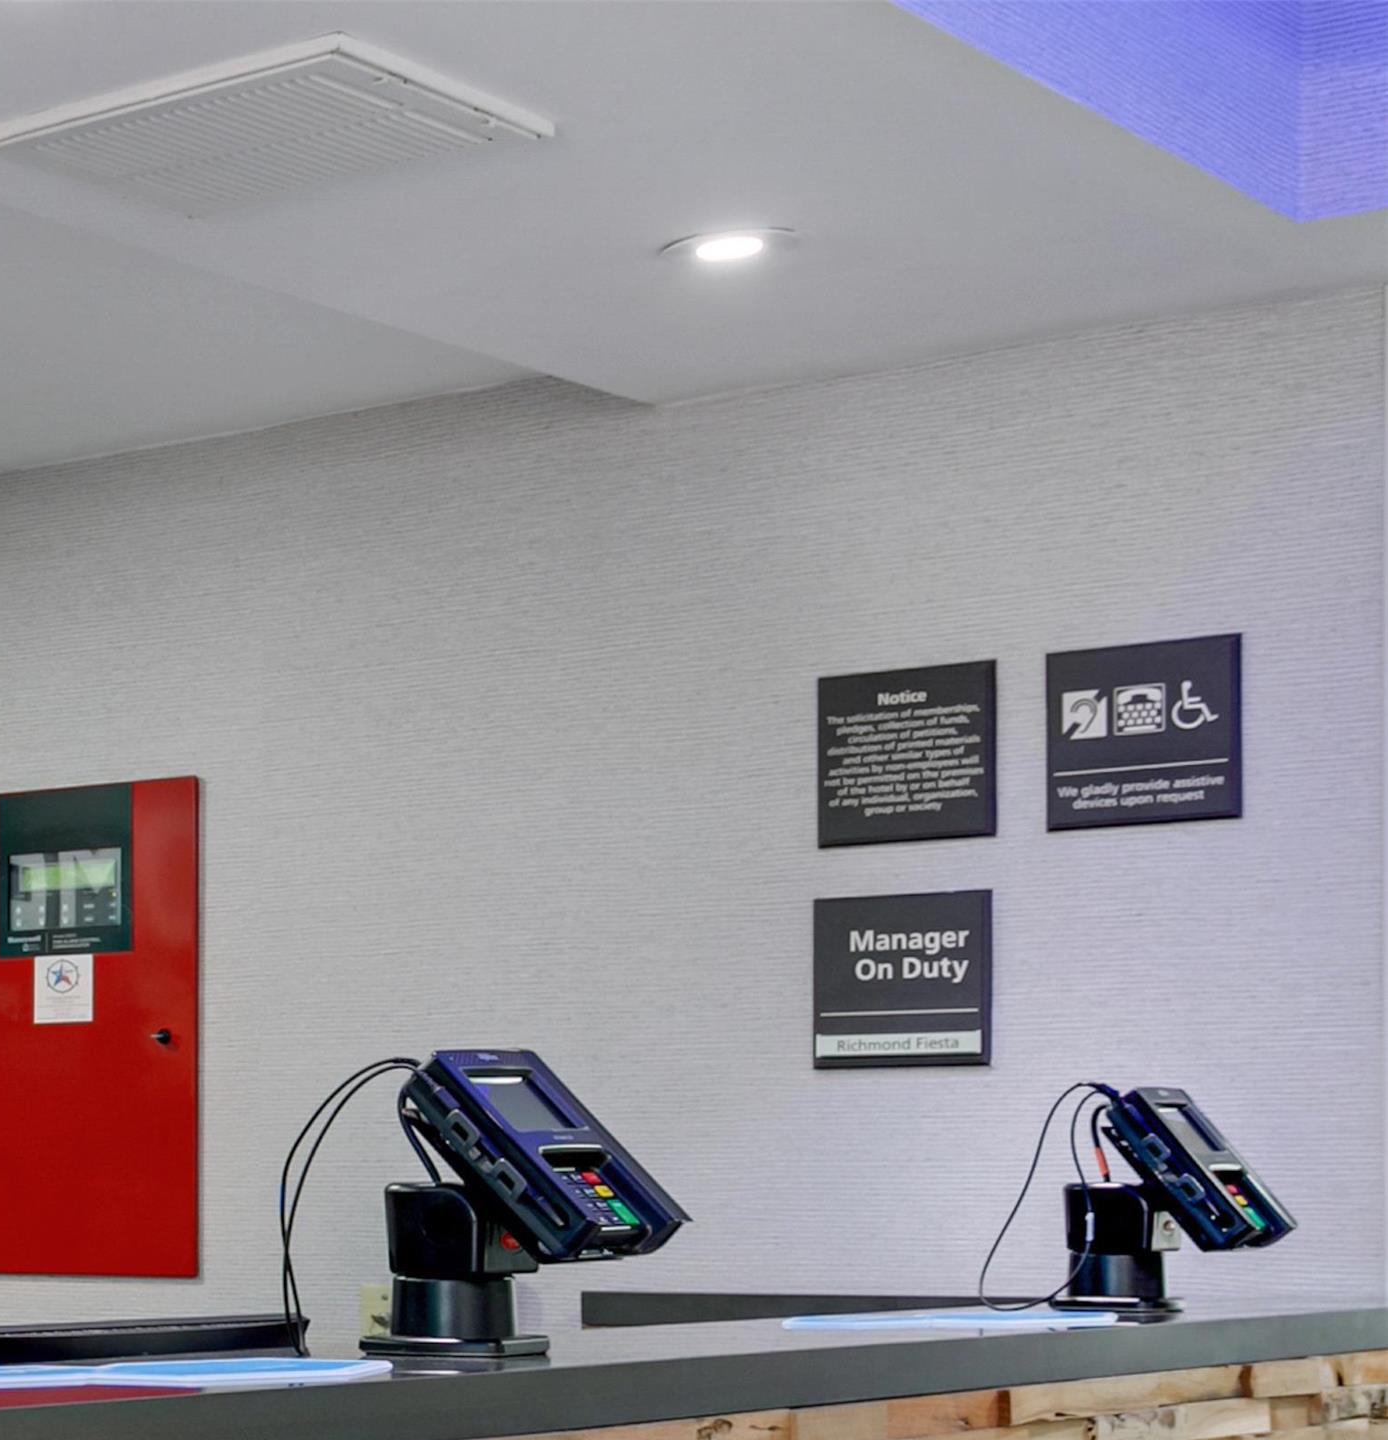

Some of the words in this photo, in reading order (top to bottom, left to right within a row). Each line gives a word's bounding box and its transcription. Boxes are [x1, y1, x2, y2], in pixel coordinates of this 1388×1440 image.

[877, 690, 927, 706] Notice
[827, 716, 844, 725] The
[900, 709, 912, 718] of
[927, 717, 937, 726] of
[900, 730, 911, 739] of
[884, 742, 895, 751] of
[897, 739, 933, 751] printed
[935, 735, 981, 746] materials
[843, 756, 861, 765] and
[863, 754, 889, 763] other
[925, 749, 951, 760] types
[953, 746, 964, 755] of
[872, 765, 883, 773] by
[824, 778, 840, 787] not
[843, 777, 855, 785] be
[907, 772, 920, 780] on
[922, 770, 939, 778] the
[837, 787, 848, 796] of
[850, 786, 866, 795] the
[868, 784, 893, 793] hotel
[895, 783, 908, 793] by
[909, 783, 920, 791] or
[938, 777, 970, 788] behalf
[1057, 787, 1078, 798] We
[1080, 782, 1120, 797] gladly
[1122, 778, 1170, 793] provide
[1173, 775, 1224, 787] assistive
[829, 798, 839, 807] of
[841, 798, 859, 807] any
[1073, 798, 1118, 809] devices
[1120, 794, 1154, 807] upon
[1156, 789, 1204, 803] request
[864, 806, 894, 817] group
[908, 802, 943, 812] society
[849, 929, 969, 955] Manager
[855, 958, 893, 981] On
[902, 957, 969, 983] Duty
[837, 1037, 911, 1052] Richmond
[916, 1037, 959, 1050] Fiesta
